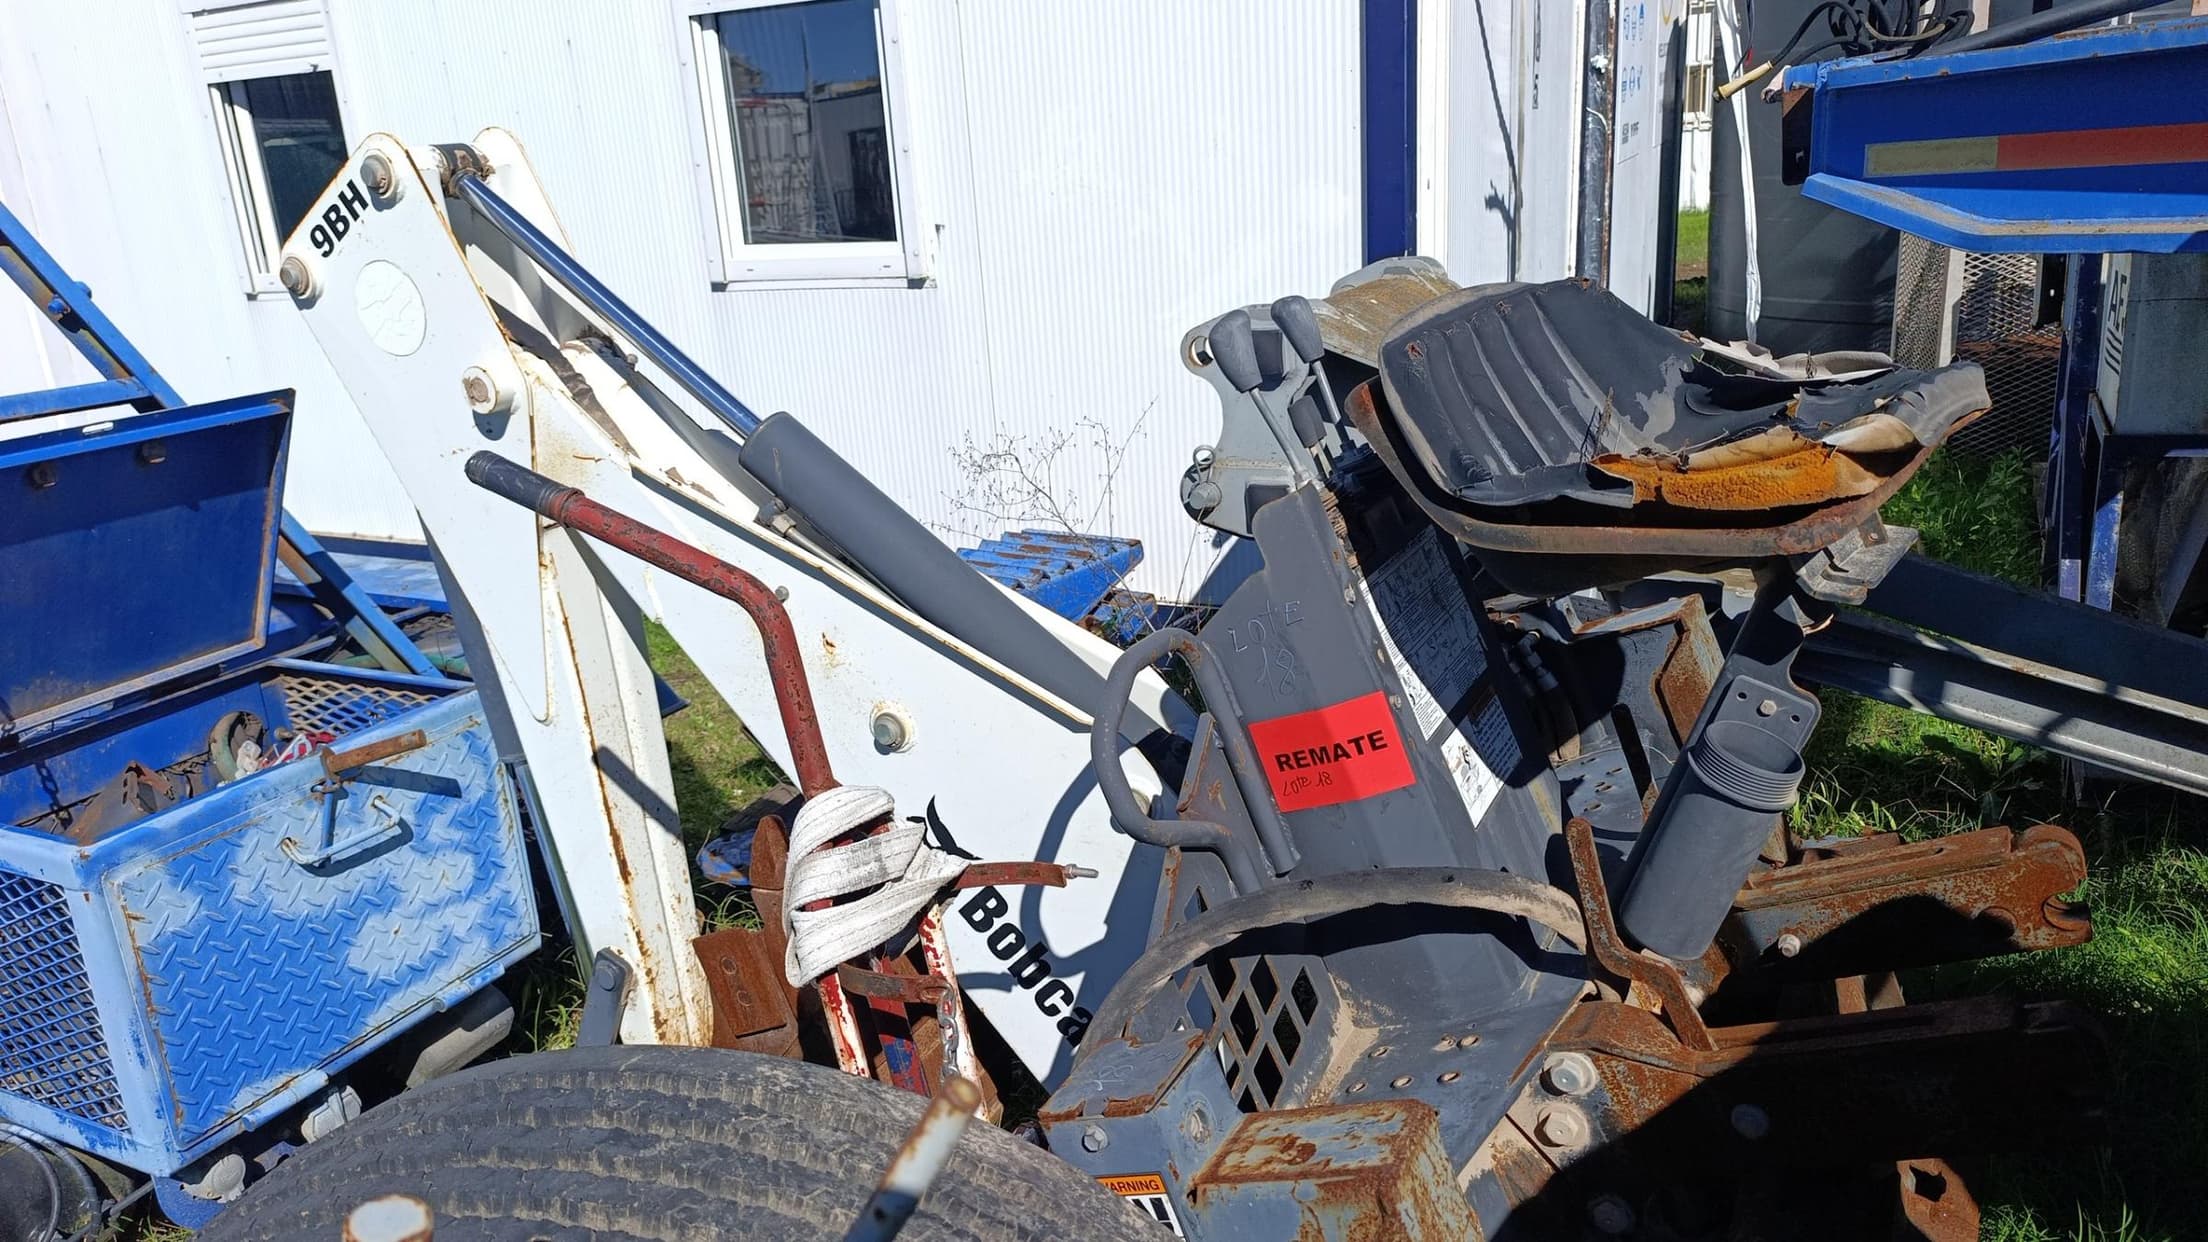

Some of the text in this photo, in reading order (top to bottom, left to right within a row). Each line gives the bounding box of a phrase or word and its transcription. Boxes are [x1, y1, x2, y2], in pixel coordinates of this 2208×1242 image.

[310, 178, 369, 258] 9BH
[1274, 730, 1388, 773] REMATE
[958, 885, 1094, 1049] Bobca
[1104, 1180, 1160, 1193] ARNING
